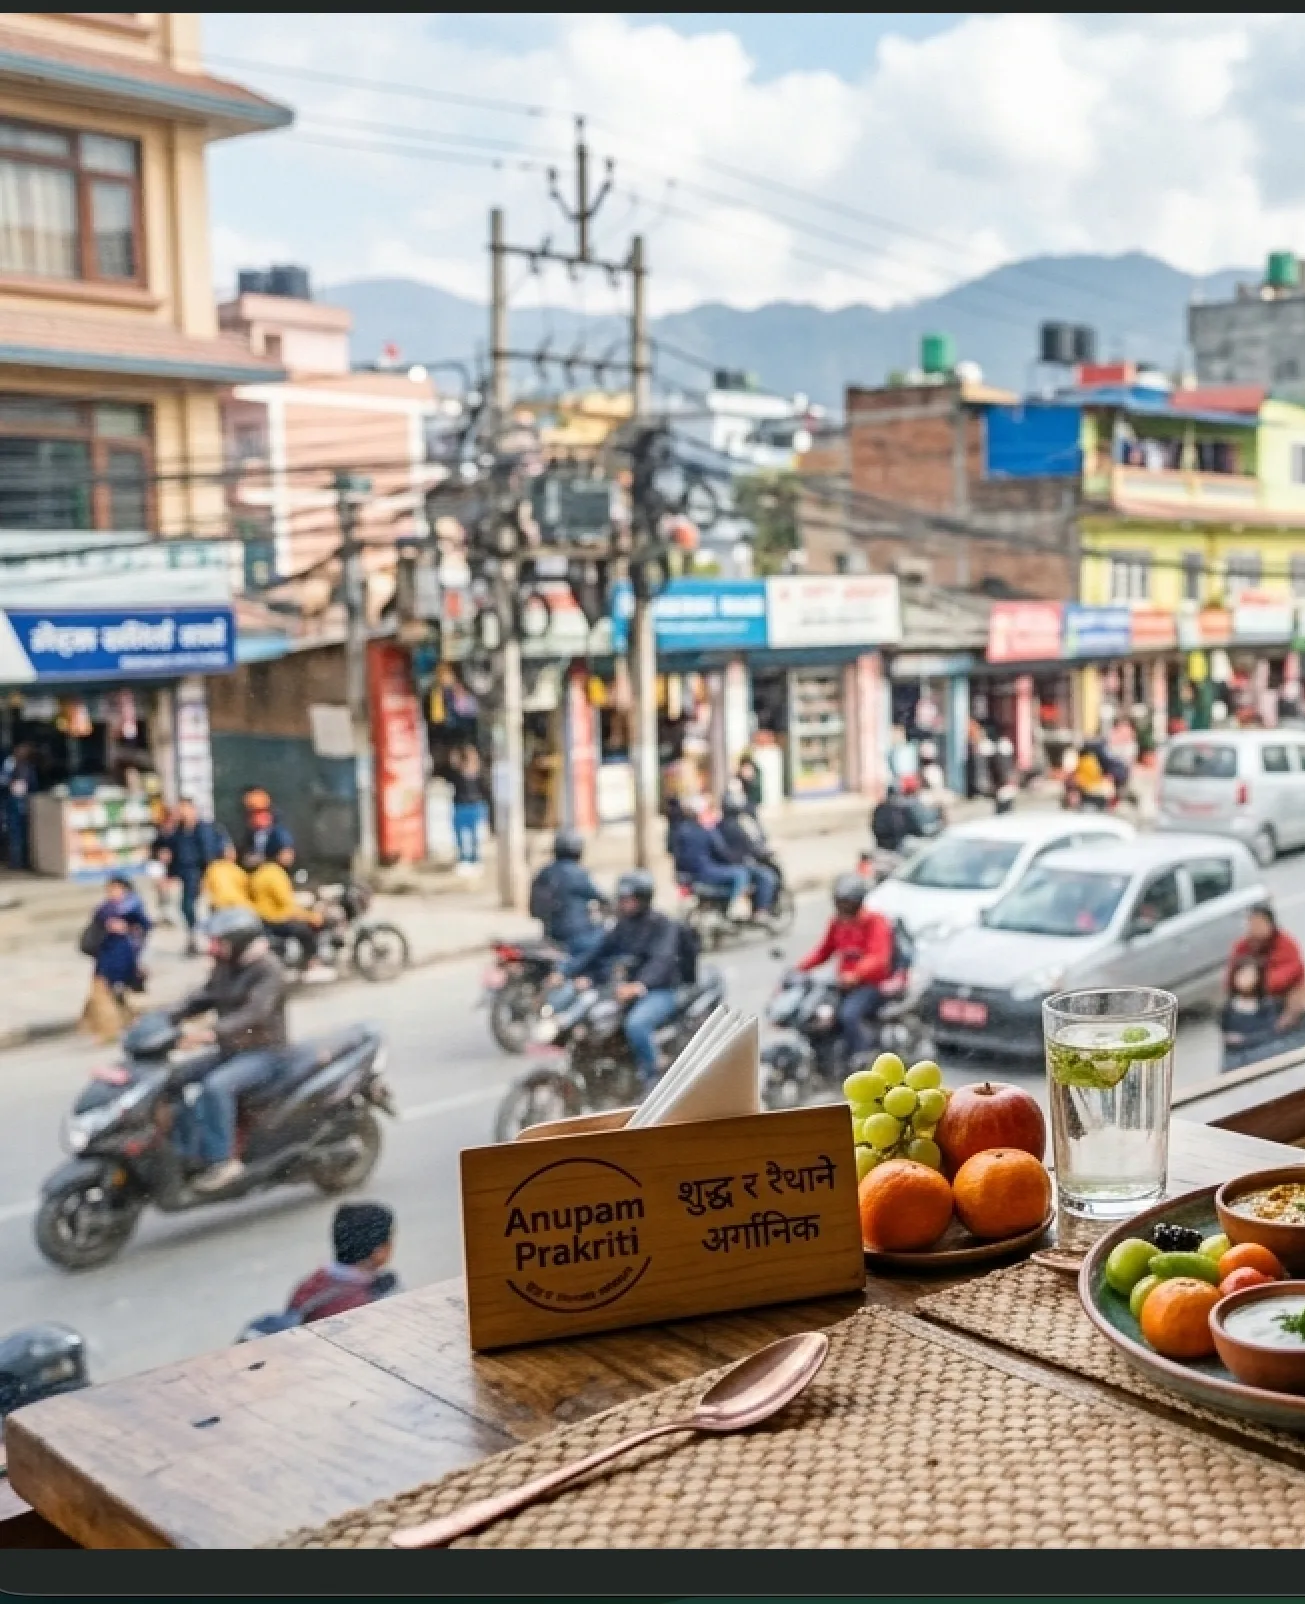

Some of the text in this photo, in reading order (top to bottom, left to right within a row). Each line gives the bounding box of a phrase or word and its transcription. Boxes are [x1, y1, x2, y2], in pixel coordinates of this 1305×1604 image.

[678, 1176, 735, 1216] शुद्ध
[742, 1172, 759, 1199] र
[504, 1197, 644, 1237] Anupam
[702, 1210, 821, 1253] अर्गानिक
[515, 1227, 639, 1271] Prakriti
